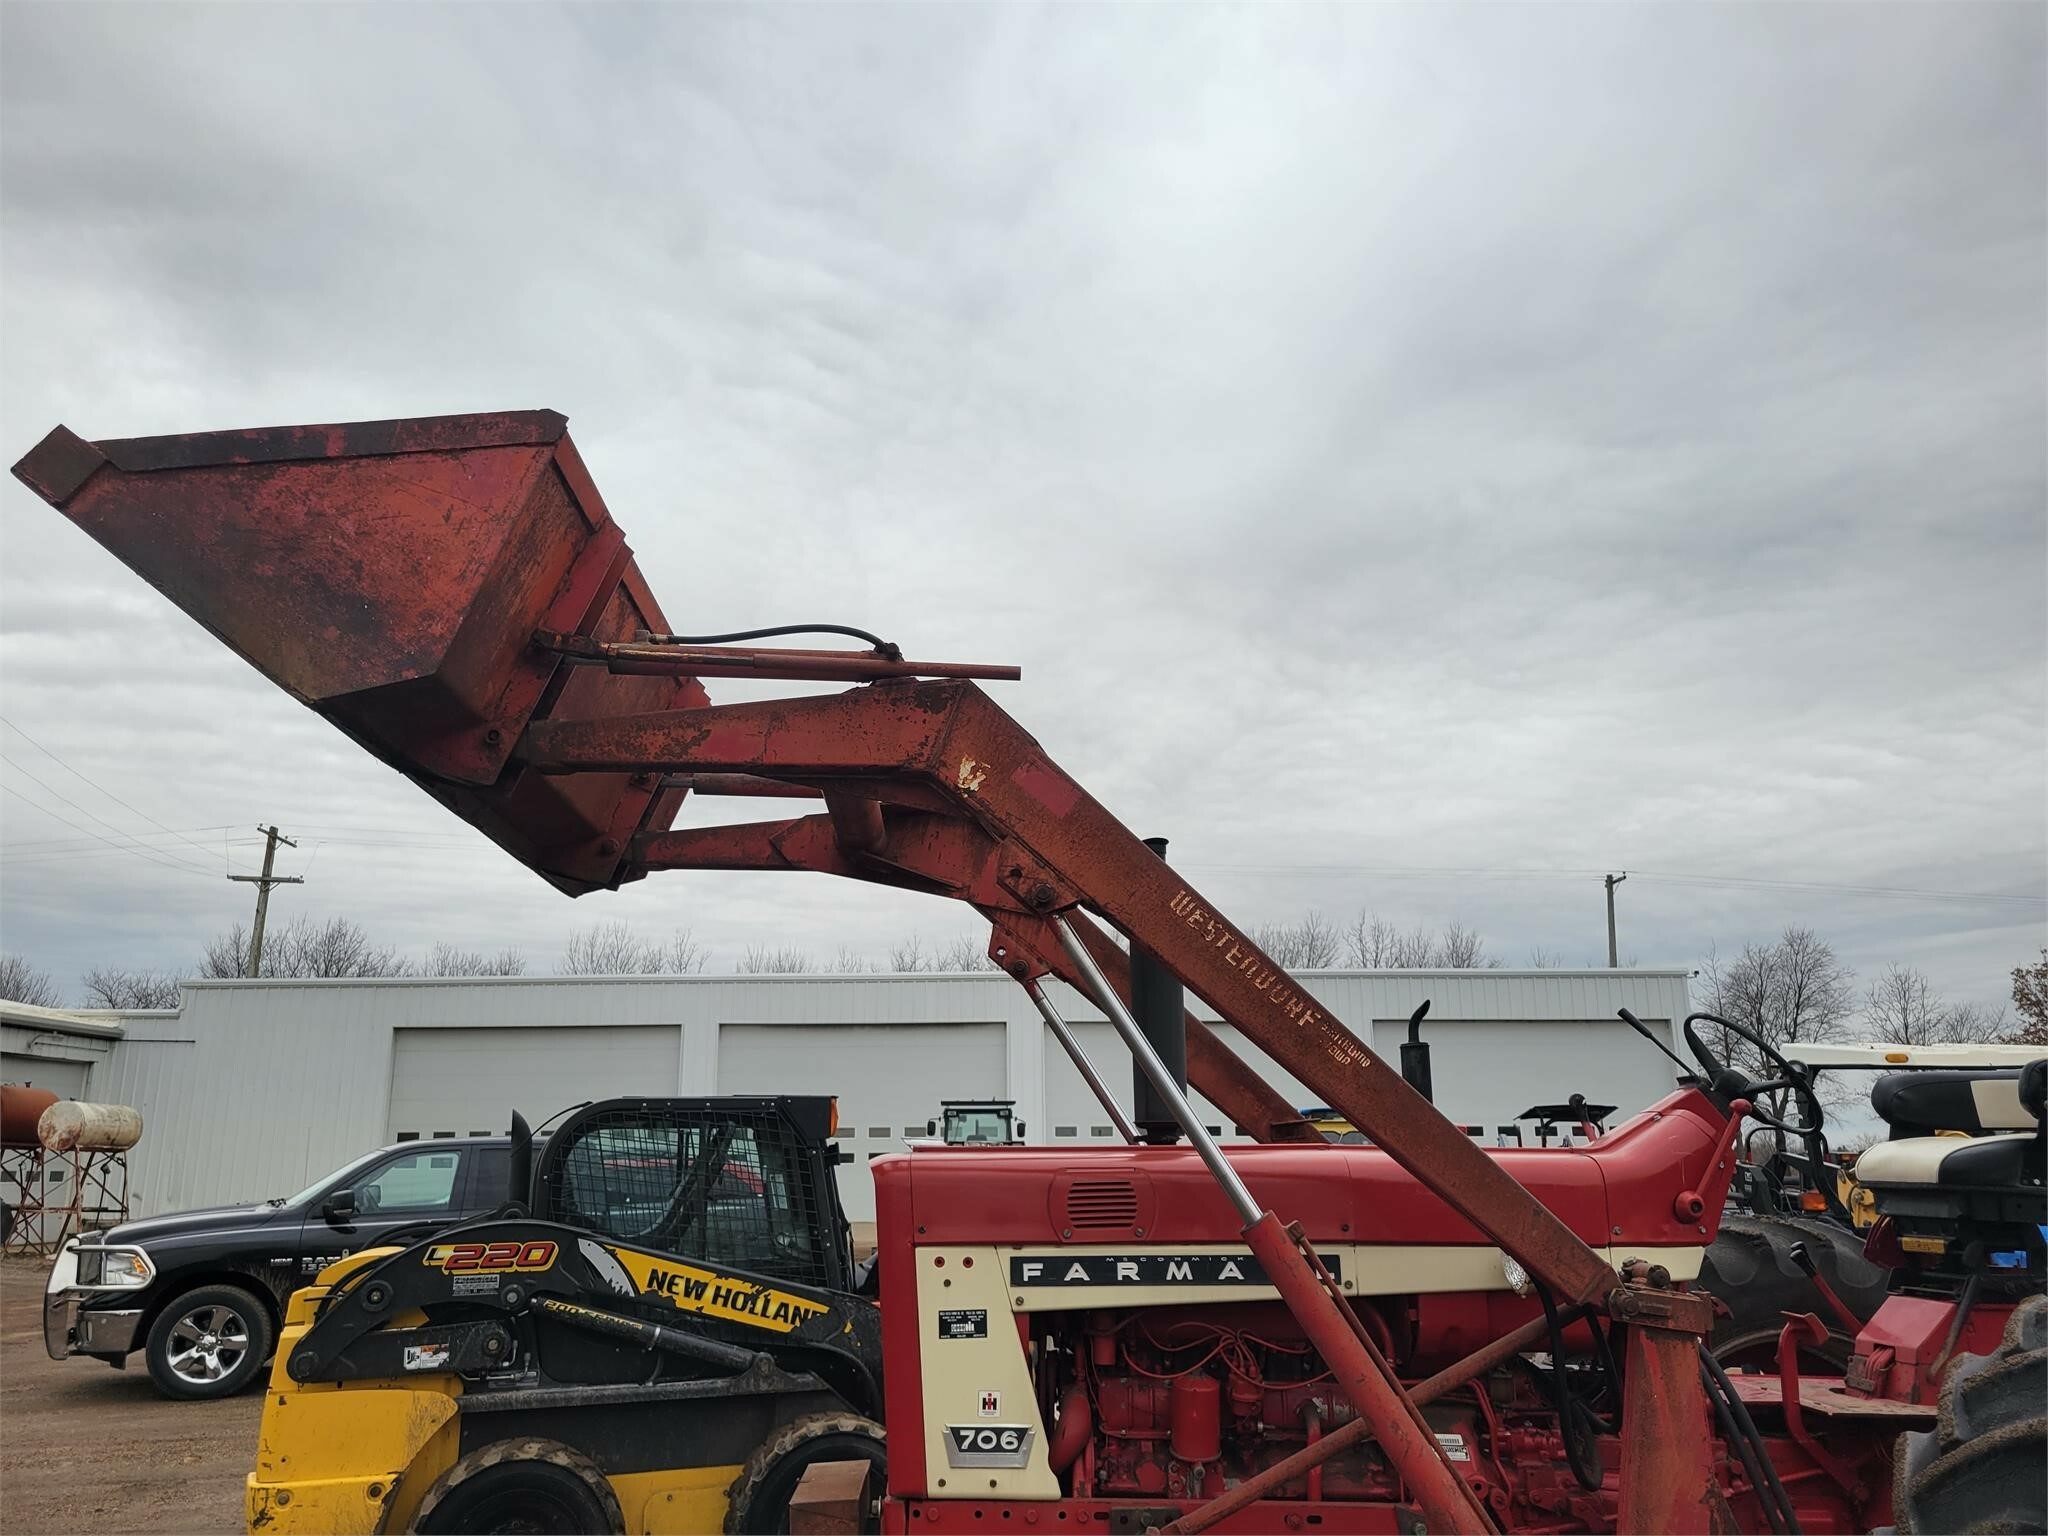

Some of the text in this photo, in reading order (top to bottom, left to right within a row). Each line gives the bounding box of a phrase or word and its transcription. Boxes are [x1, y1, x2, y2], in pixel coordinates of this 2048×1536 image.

[424, 1242, 558, 1271] L220
[1022, 1261, 1335, 1282] FARMA
[647, 1268, 822, 1326] NEW HOLLAN
[959, 1429, 1019, 1450] 706
